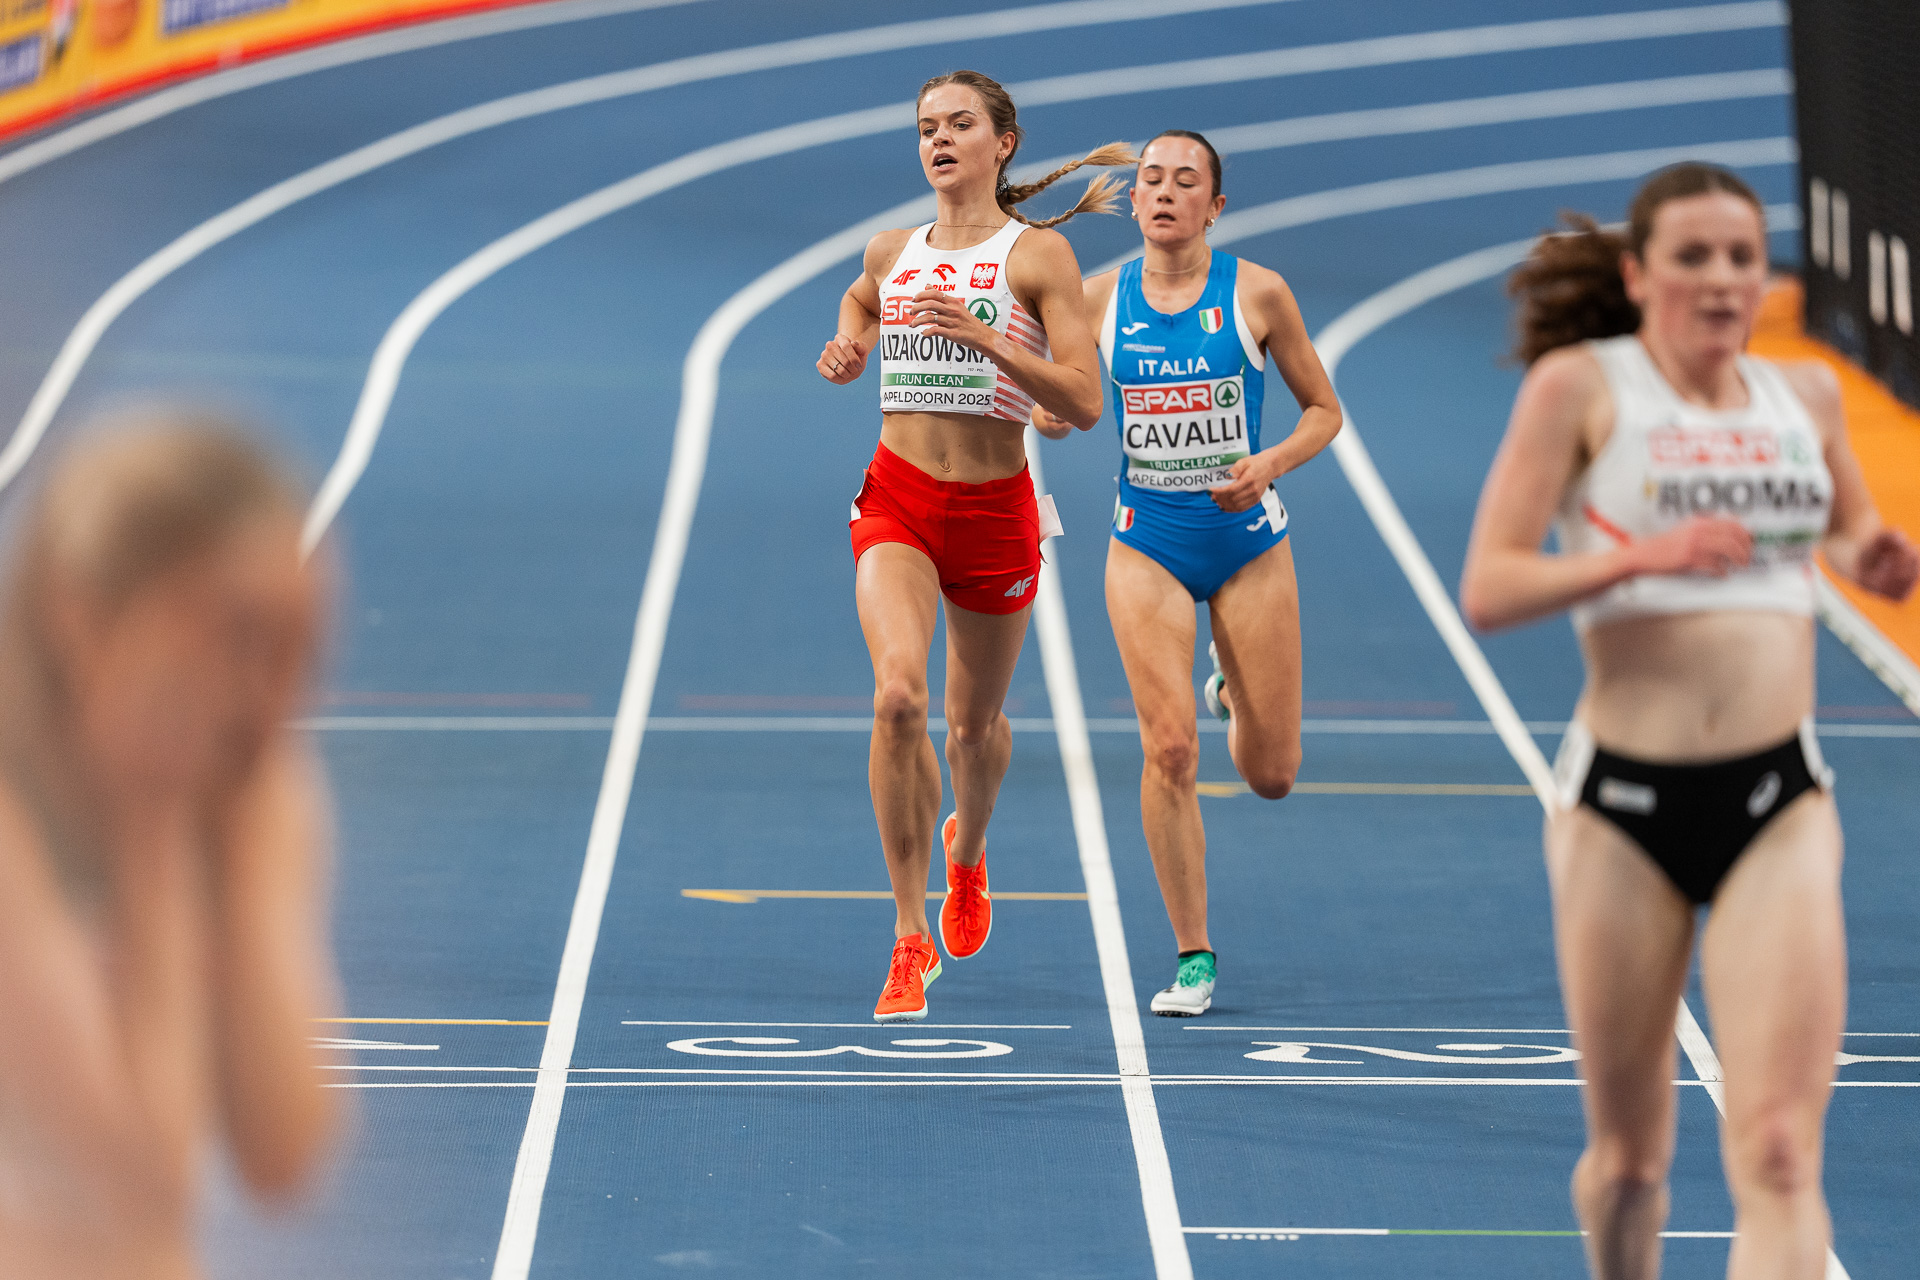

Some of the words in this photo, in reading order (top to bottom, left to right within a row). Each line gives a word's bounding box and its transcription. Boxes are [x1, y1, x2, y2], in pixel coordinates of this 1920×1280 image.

[892, 269, 921, 285] 4F
[1138, 356, 1210, 376] ITALIA
[896, 374, 900, 385] I
[900, 374, 922, 385] RUN
[883, 391, 954, 405] APELDOORN
[958, 393, 992, 406] 2025
[1126, 388, 1210, 411] SPAR
[1126, 415, 1242, 449] CAVALLI
[1155, 460, 1180, 471] RUN
[1132, 471, 1213, 487] APELDOORN
[1004, 574, 1035, 597] 4F
